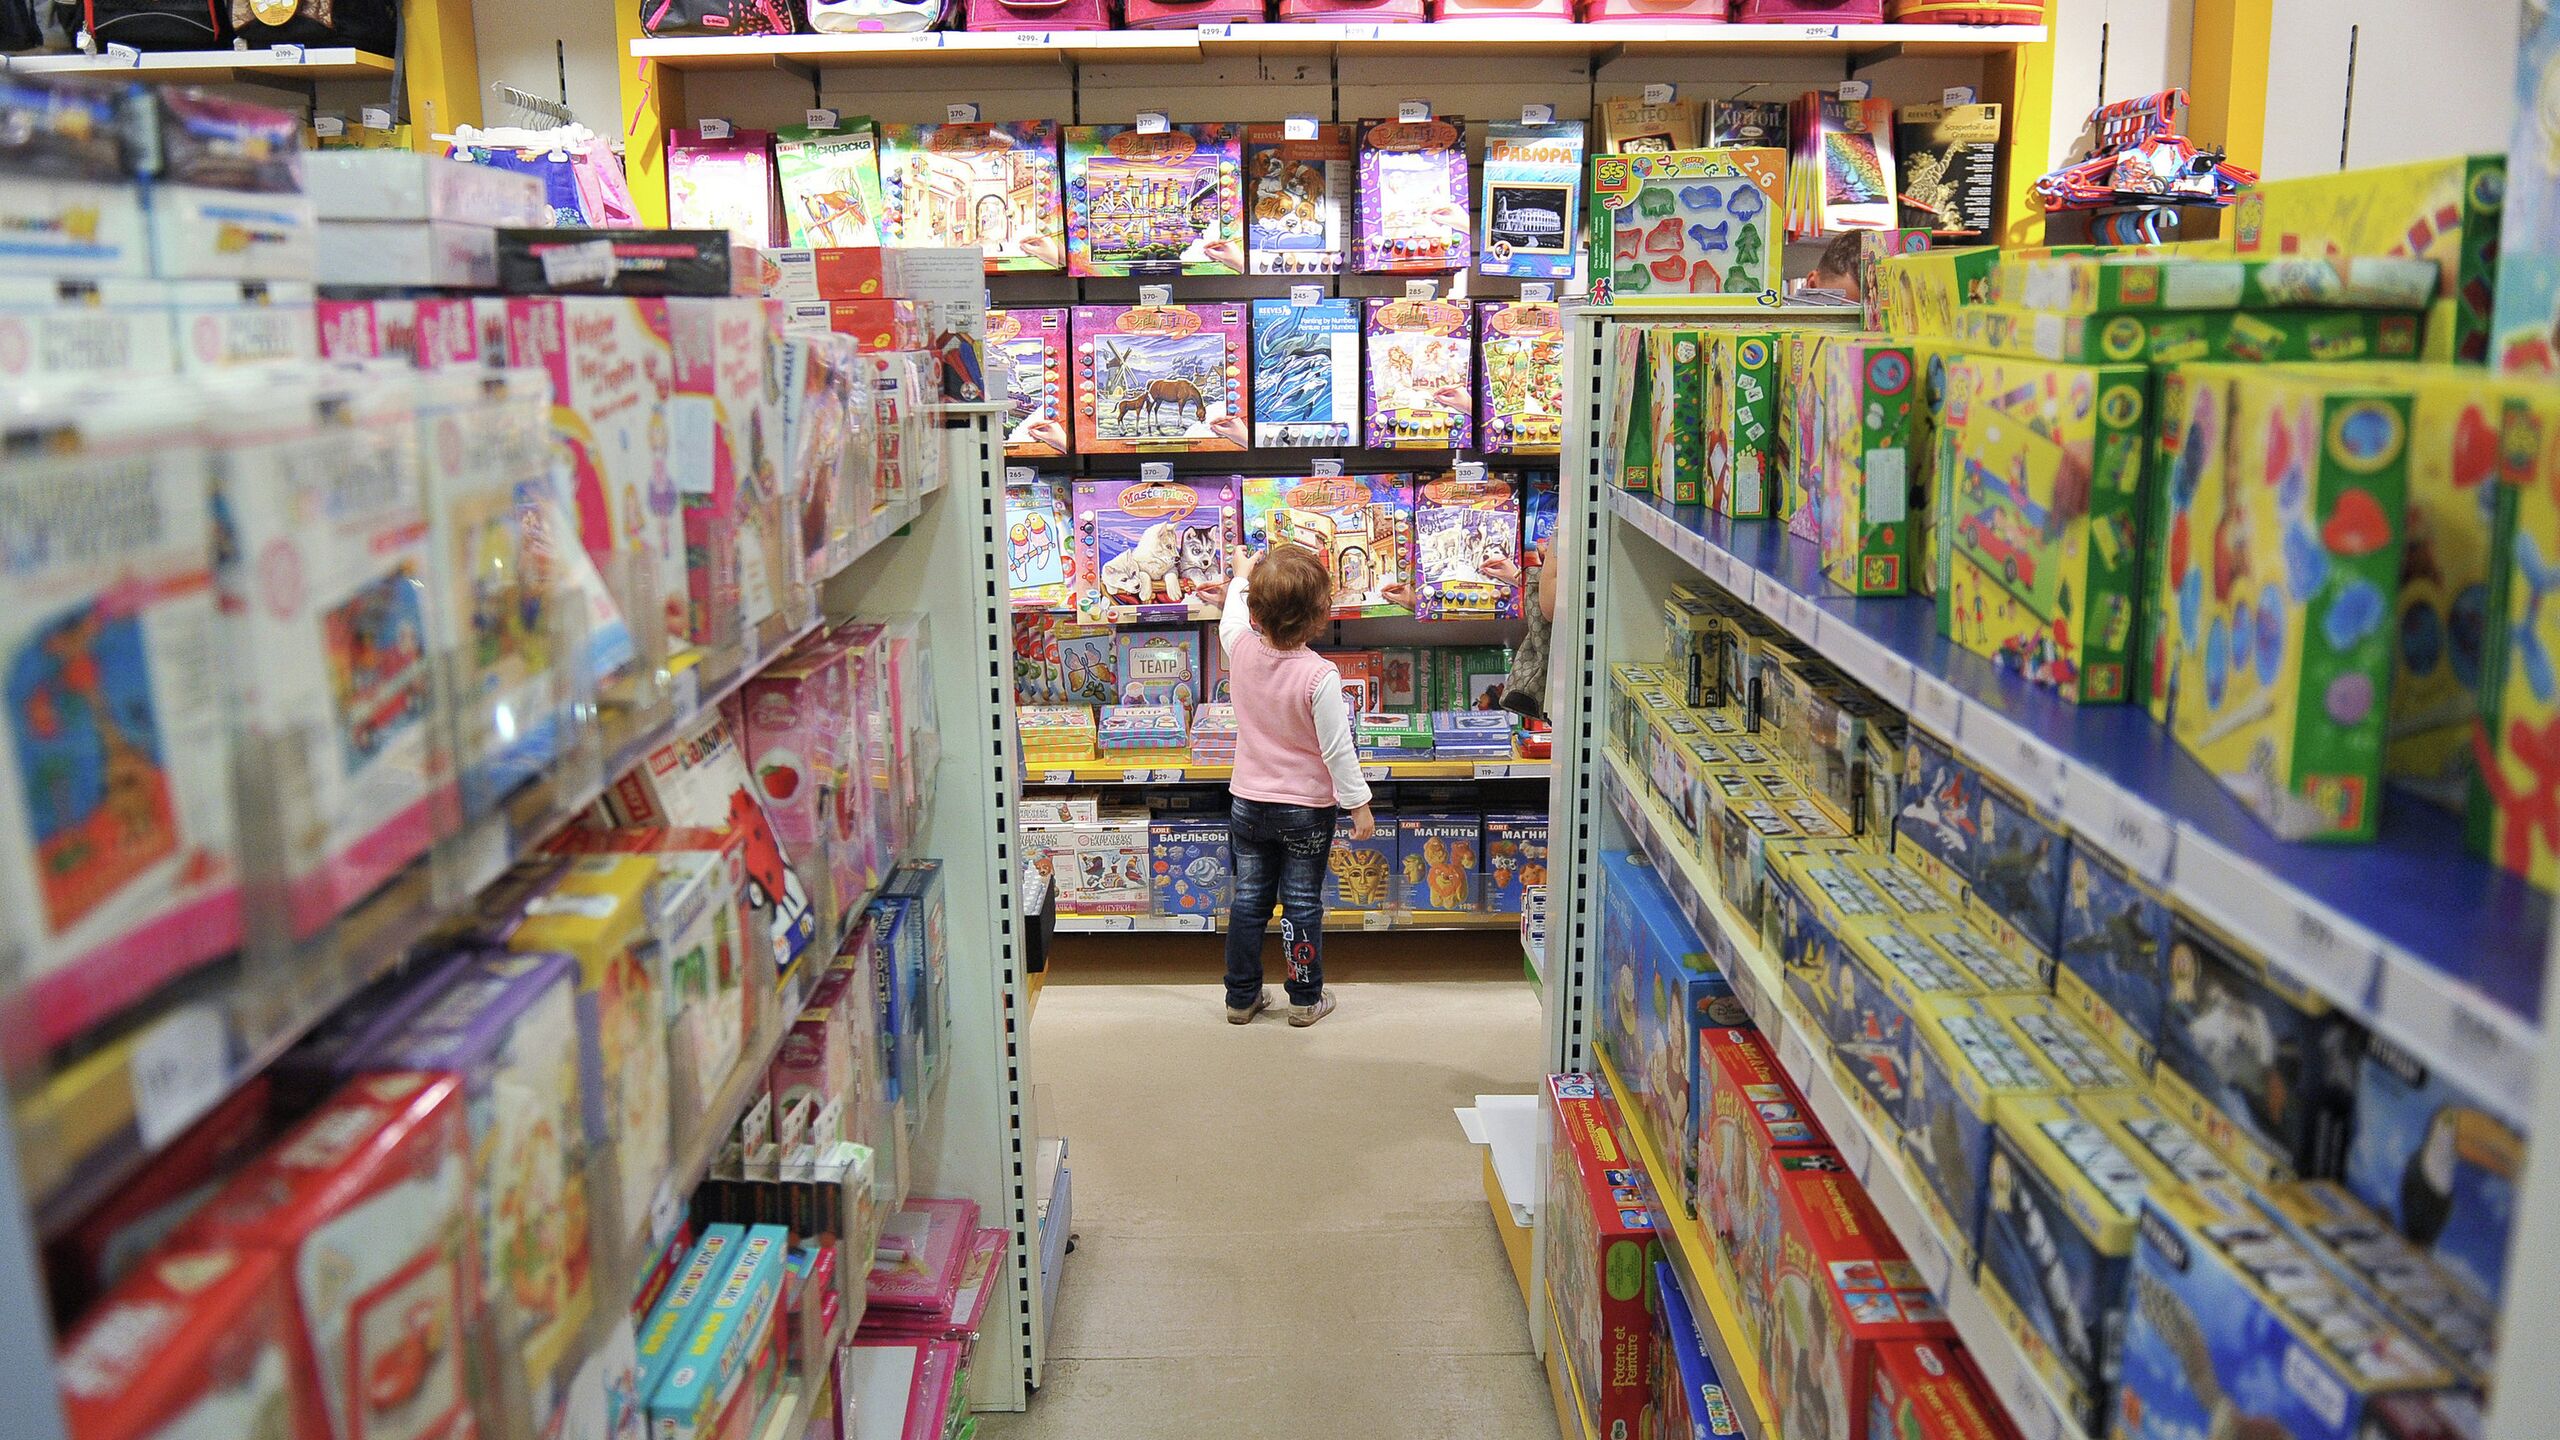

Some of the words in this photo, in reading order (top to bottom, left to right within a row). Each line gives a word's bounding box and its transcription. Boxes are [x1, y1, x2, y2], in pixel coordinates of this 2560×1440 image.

[1599, 161, 1626, 179] SES
[1122, 486, 1196, 507] Masterpiece
[1139, 659, 1177, 674] ТЕАТР
[1160, 833, 1229, 843] БАРЕЛЬЕФЫ
[1414, 828, 1478, 837] МАГНИТЫ
[1502, 830, 1549, 839] МАГНИ
[1613, 1326, 1626, 1340] et
[1612, 1344, 1626, 1387] Poterie
[1625, 1335, 1638, 1386] Peinture
